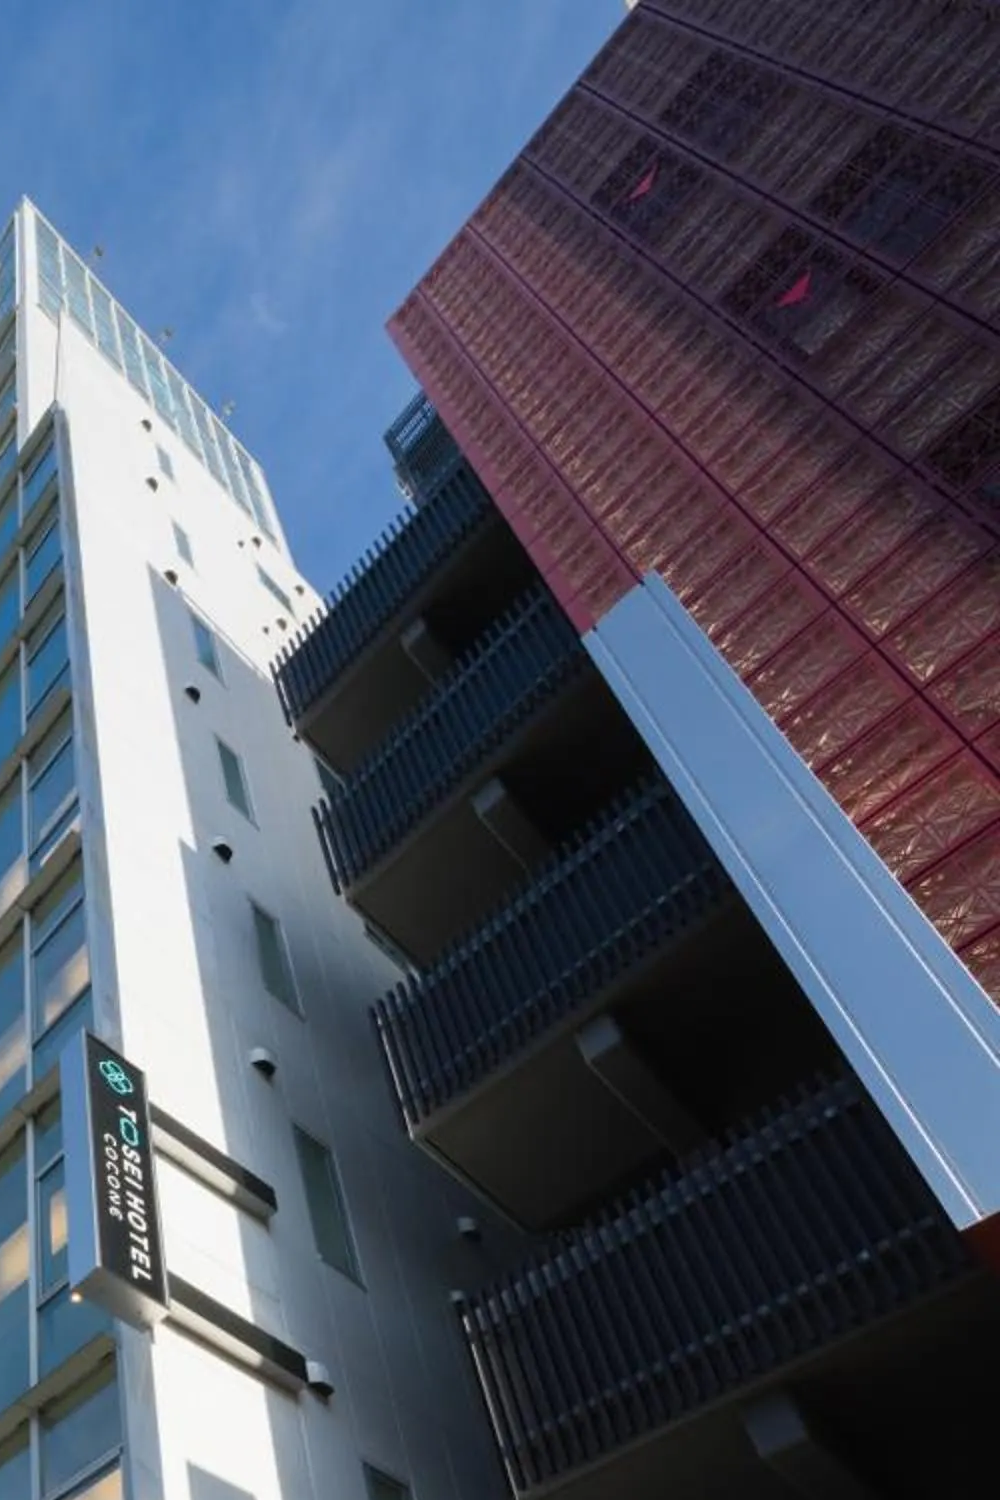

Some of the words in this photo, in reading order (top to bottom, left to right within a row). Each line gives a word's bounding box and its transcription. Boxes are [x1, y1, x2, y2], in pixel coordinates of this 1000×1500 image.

[103, 1133, 123, 1221] COCONE
[117, 1105, 144, 1193] TOSEI
[126, 1193, 152, 1281] HOTEL
